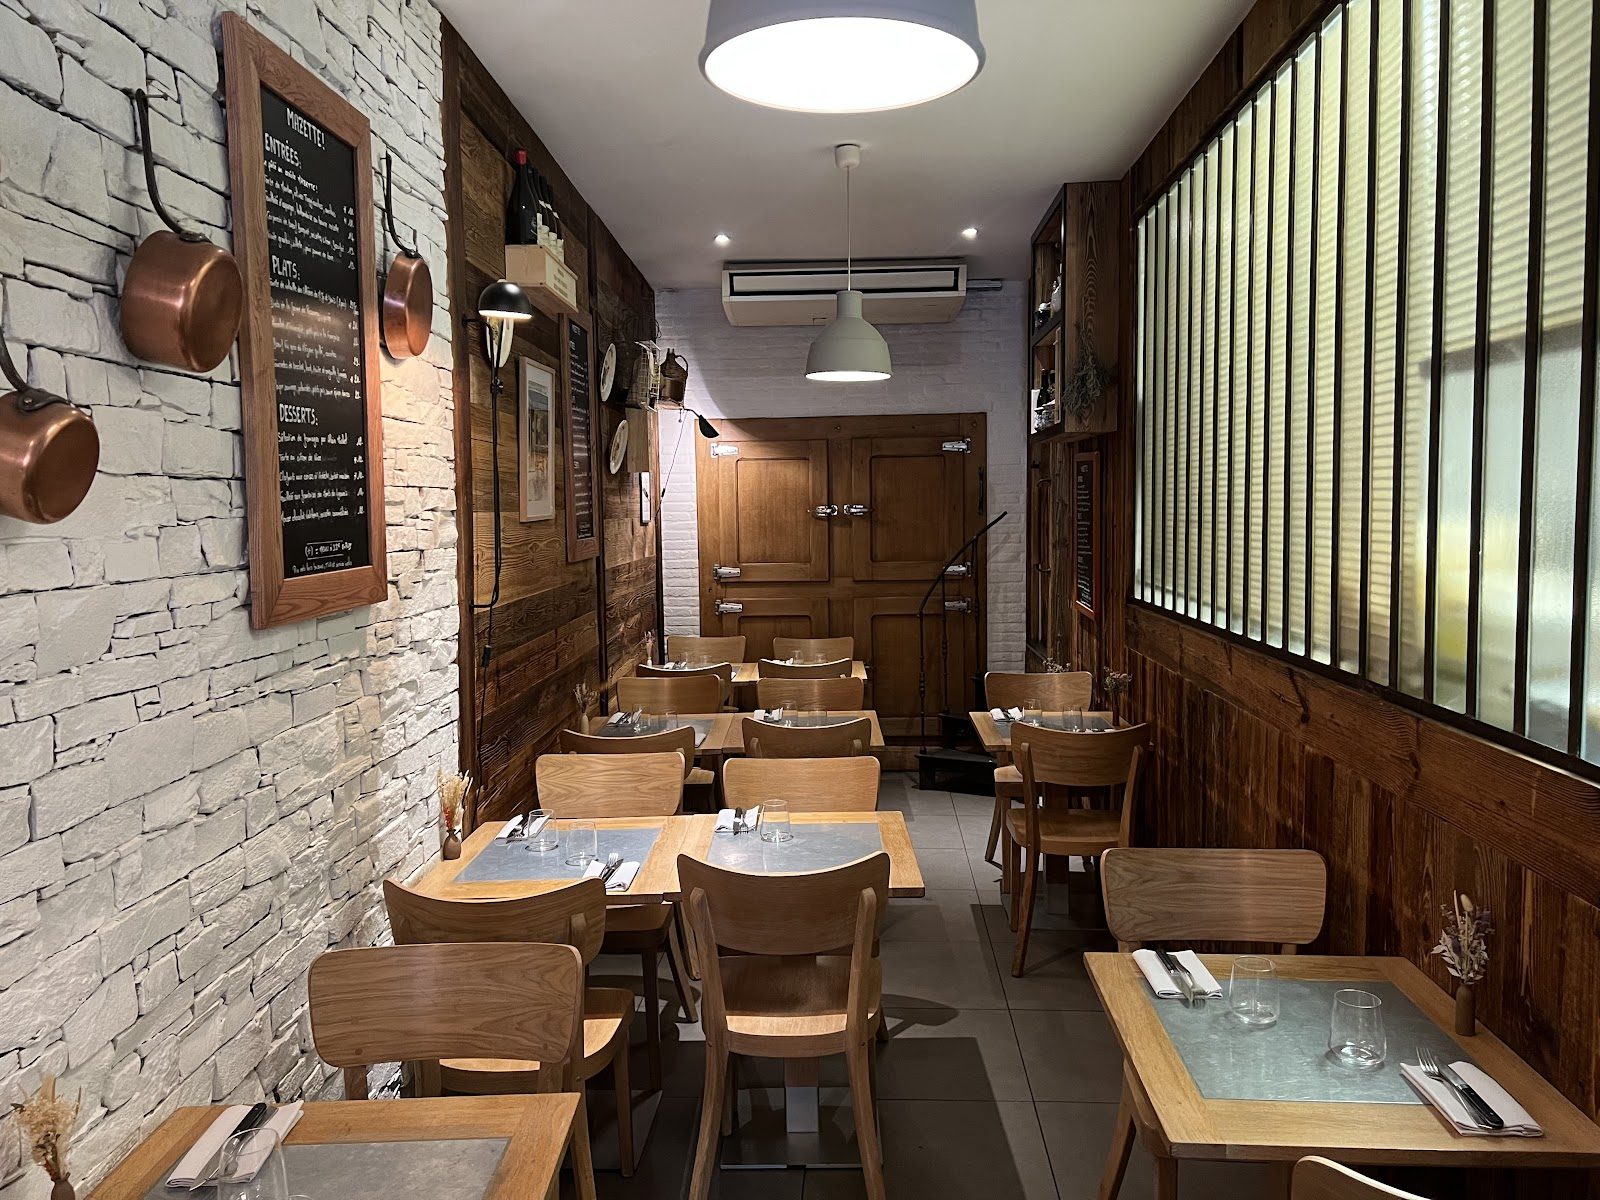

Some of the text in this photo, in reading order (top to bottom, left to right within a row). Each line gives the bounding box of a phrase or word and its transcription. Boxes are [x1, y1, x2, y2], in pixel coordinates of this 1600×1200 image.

[286, 107, 325, 150] MAZETTE!
[271, 254, 301, 280] PLATS:
[279, 403, 319, 426] DESSERTS:
